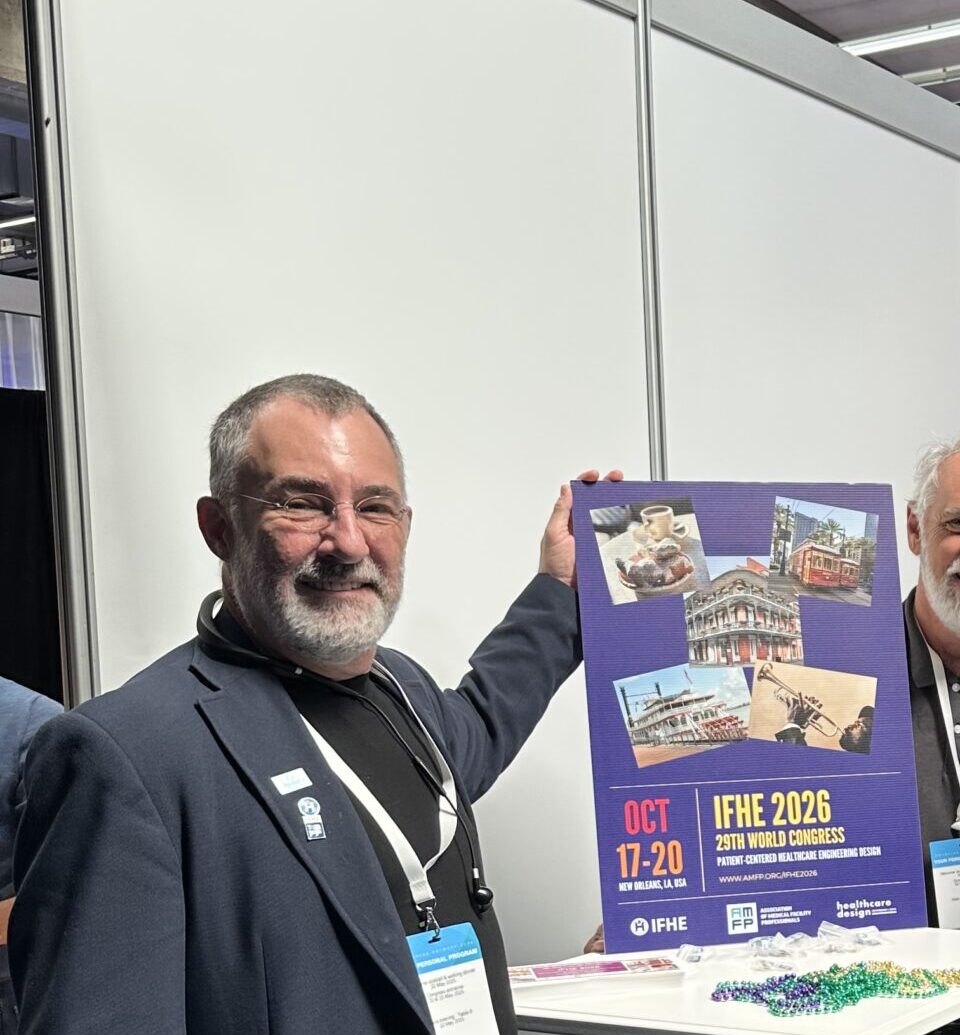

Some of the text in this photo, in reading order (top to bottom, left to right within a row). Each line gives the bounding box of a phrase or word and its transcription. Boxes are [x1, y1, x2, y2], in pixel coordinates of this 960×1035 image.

[624, 799, 670, 835] OCT
[713, 789, 832, 830] IFHE 2026
[716, 827, 846, 852] 29TH WORLD CONGRESS
[616, 840, 684, 878] 17-20
[717, 846, 882, 867] PATIENT-CENTERED HEALTHCARE ENGINEERING DESIGN
[618, 882, 632, 891] NEW
[634, 880, 663, 891] ORLEANS,
[674, 878, 687, 888] USA
[836, 899, 892, 910] healthcare
[836, 908, 871, 919] design
[651, 916, 688, 933] IFHE
[448, 947, 478, 962] PROGRAM
